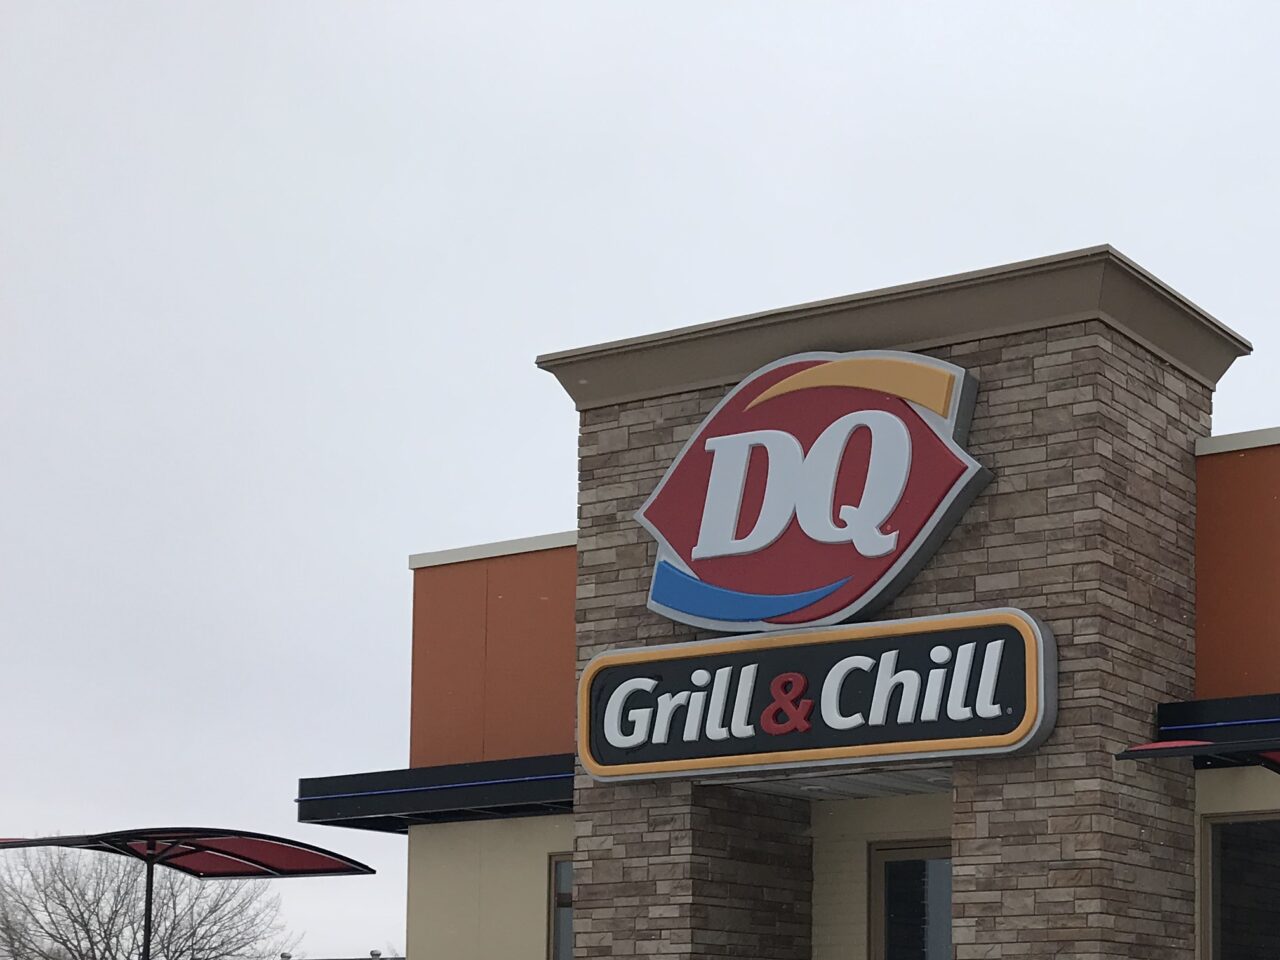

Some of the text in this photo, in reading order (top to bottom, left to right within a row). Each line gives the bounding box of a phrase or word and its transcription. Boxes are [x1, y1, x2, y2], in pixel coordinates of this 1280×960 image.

[691, 409, 912, 560] DQ
[603, 639, 1005, 749] Grill & Chill
